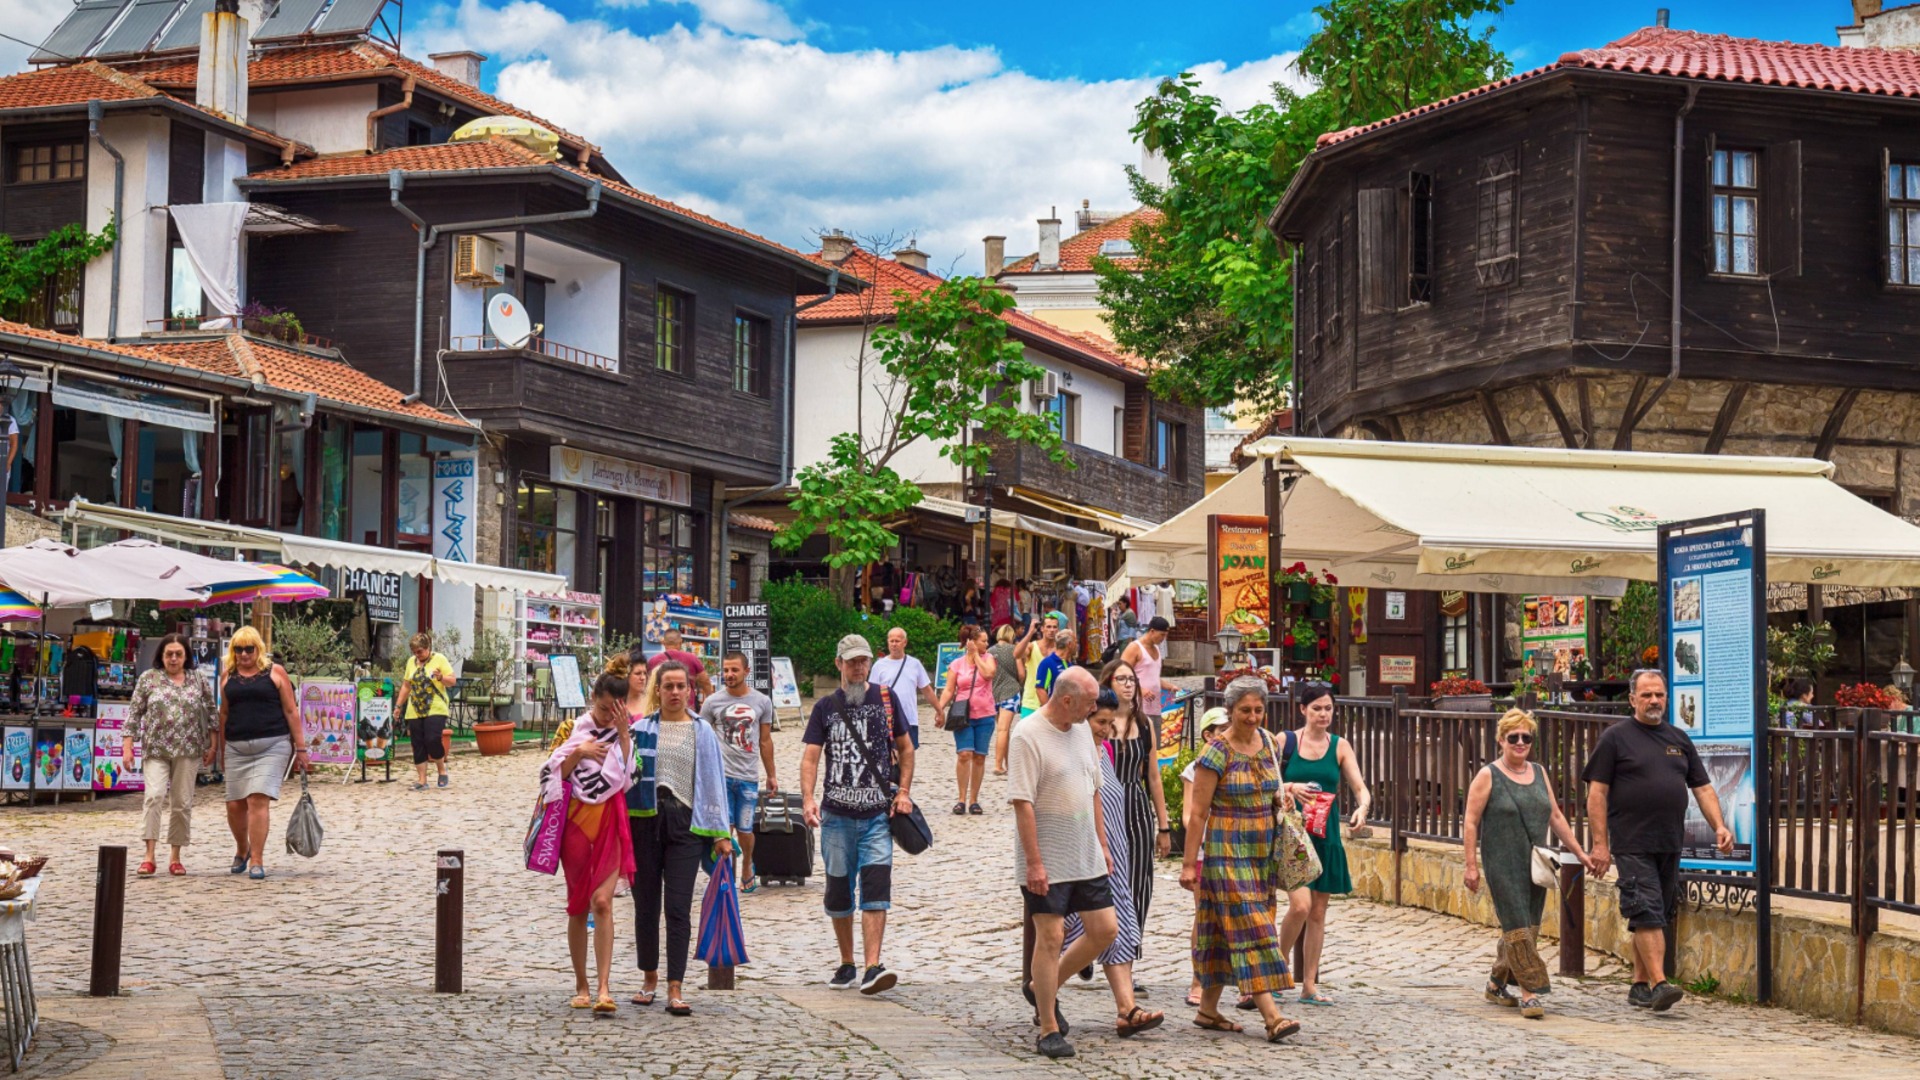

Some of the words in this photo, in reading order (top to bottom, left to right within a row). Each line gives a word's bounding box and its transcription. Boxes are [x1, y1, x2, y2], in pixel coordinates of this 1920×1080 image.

[1221, 524, 1263, 534] Restaurant
[1221, 555, 1266, 570] JOAN
[725, 605, 767, 617] CHANGE
[830, 718, 868, 741] MN
[537, 788, 567, 868] SWAROVS
